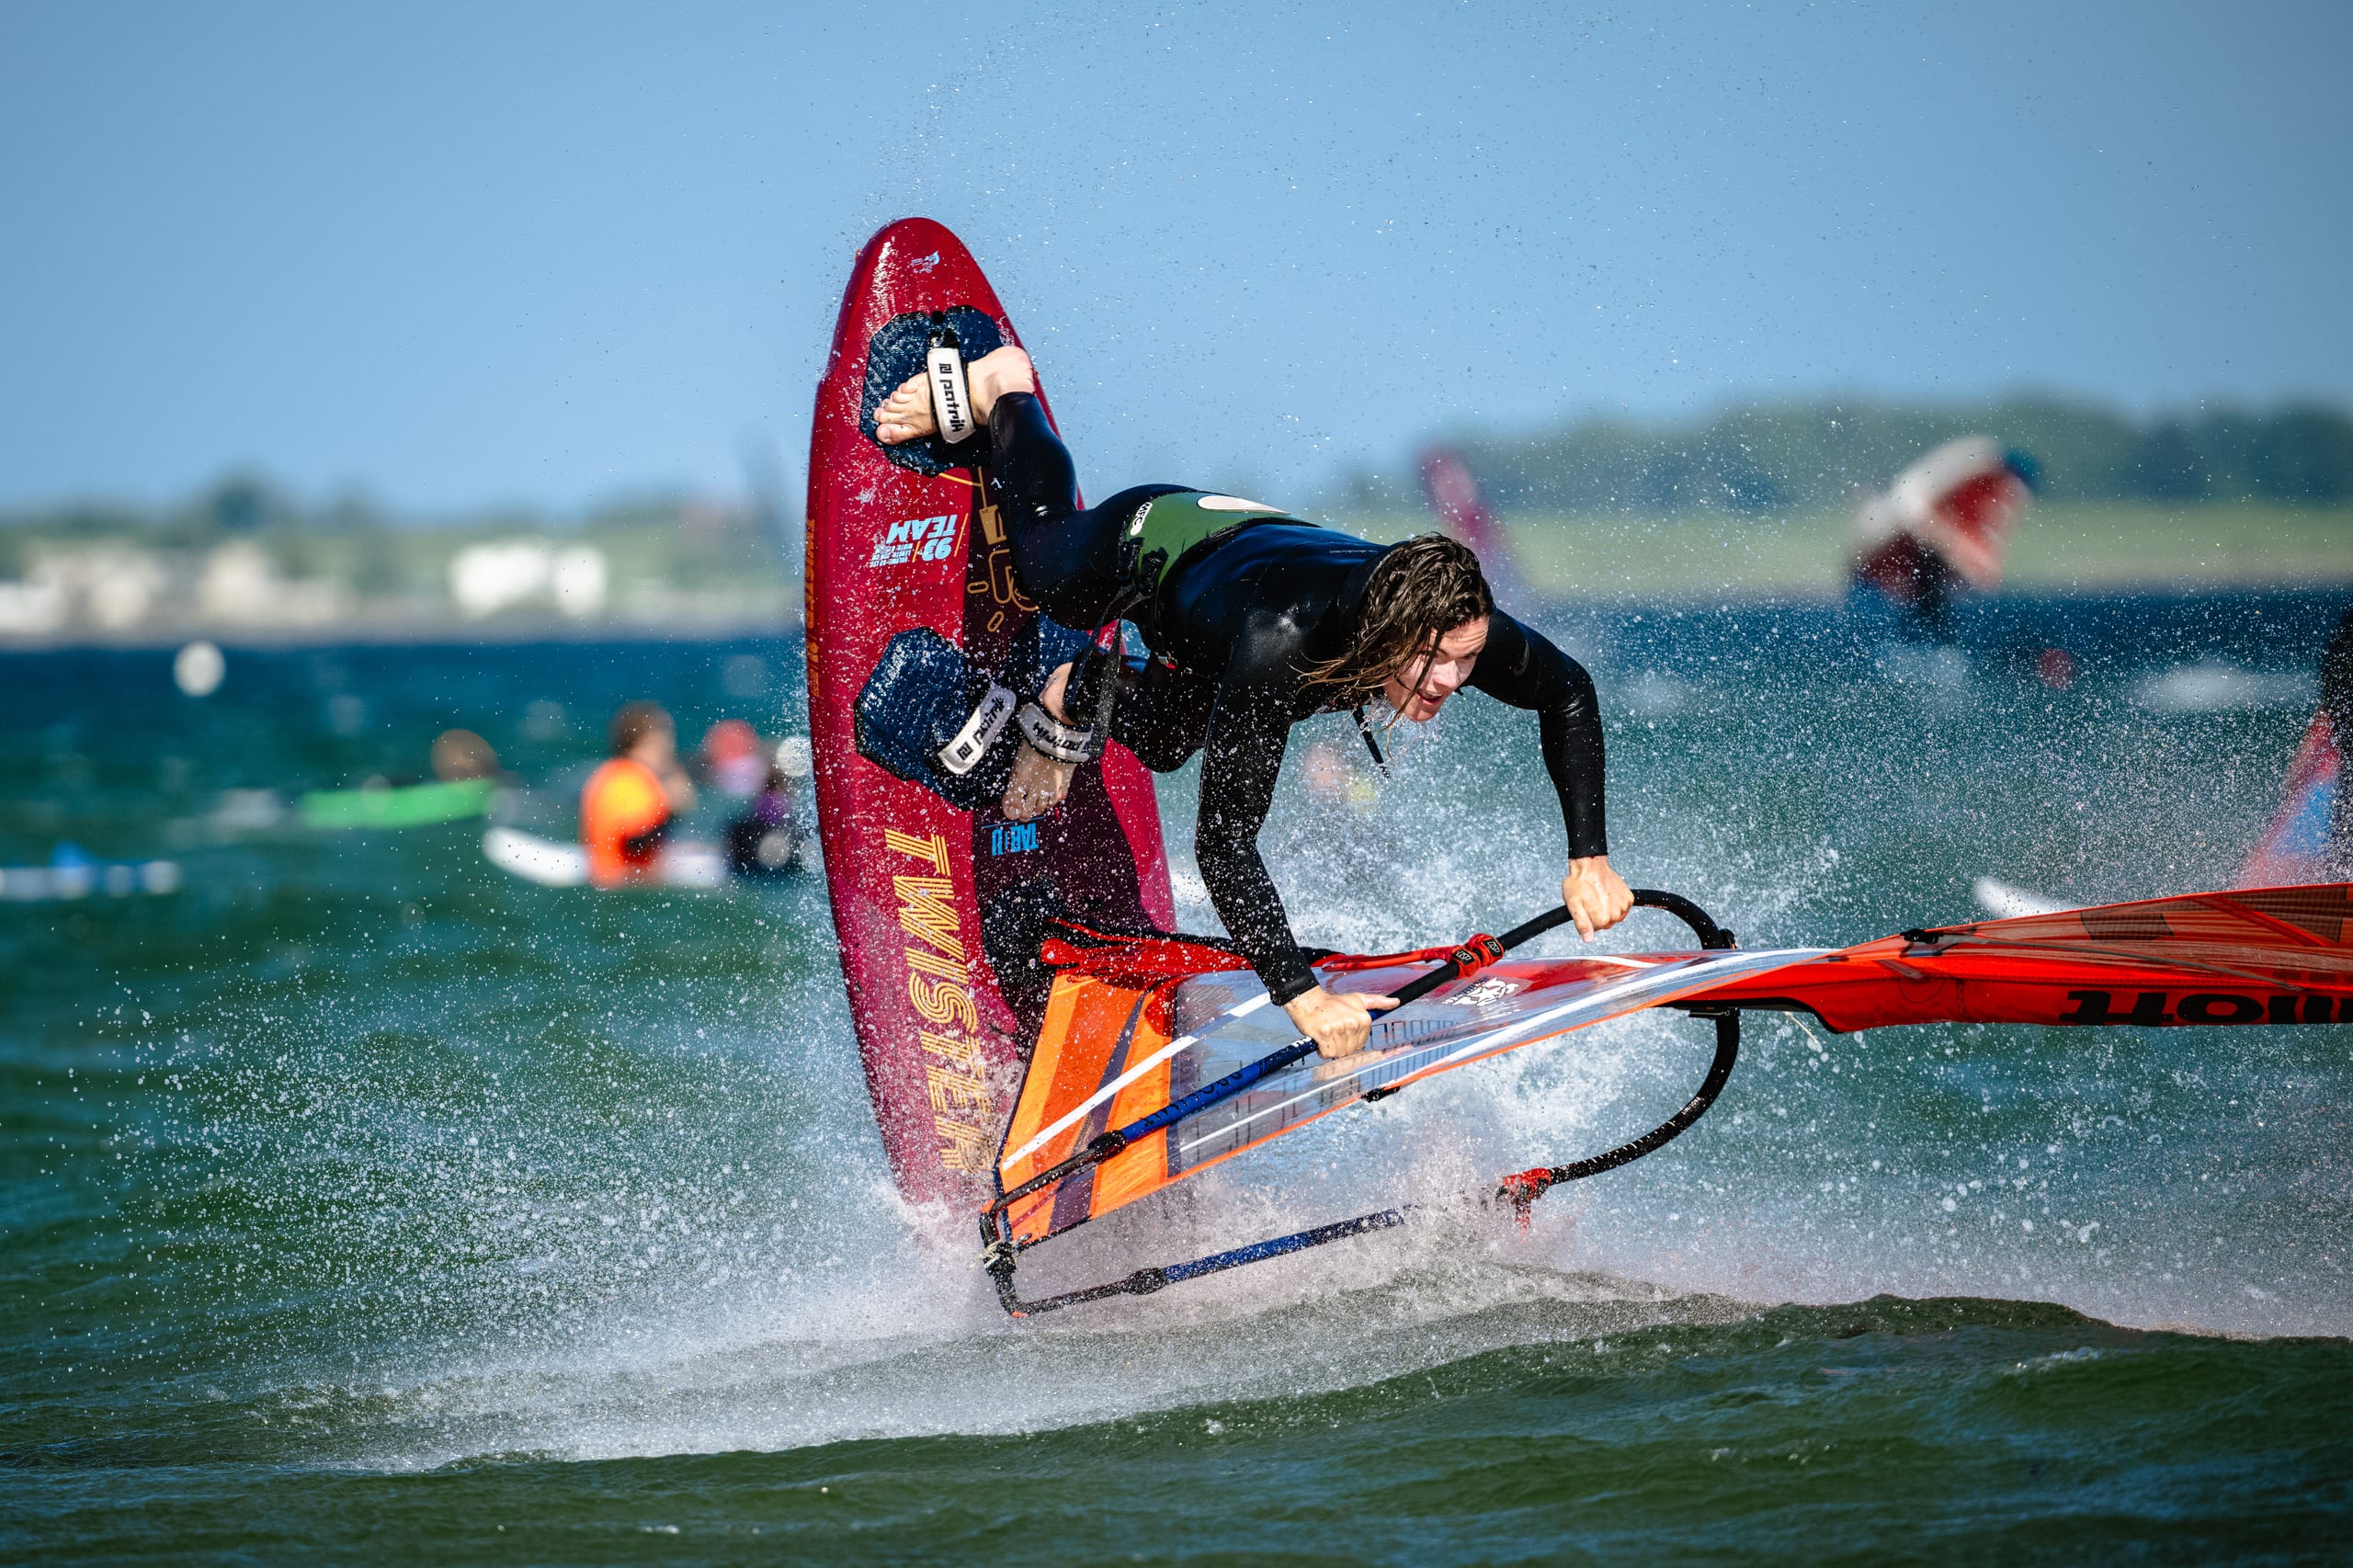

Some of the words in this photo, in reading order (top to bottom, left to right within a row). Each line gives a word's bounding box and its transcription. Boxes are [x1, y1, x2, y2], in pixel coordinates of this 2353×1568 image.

[886, 514, 958, 544] TEAM
[922, 537, 953, 562] 93
[884, 828, 995, 1174] TWISTER
